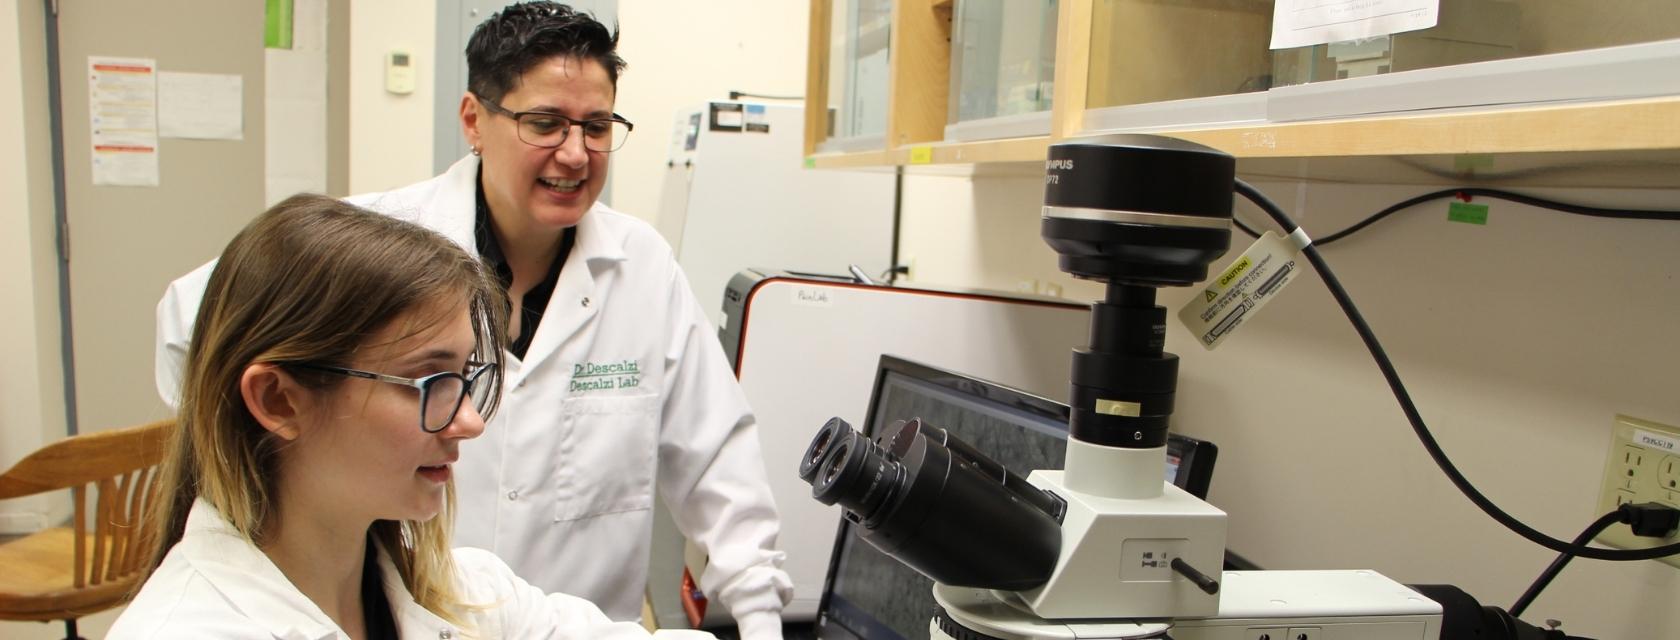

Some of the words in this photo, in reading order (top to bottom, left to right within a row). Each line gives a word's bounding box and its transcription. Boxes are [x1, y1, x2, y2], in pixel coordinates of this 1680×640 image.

[1221, 259, 1249, 286] CAUTION
[587, 360, 638, 374] Descalzi
[569, 378, 615, 392] Descalzi
[618, 376, 640, 388] Lab
